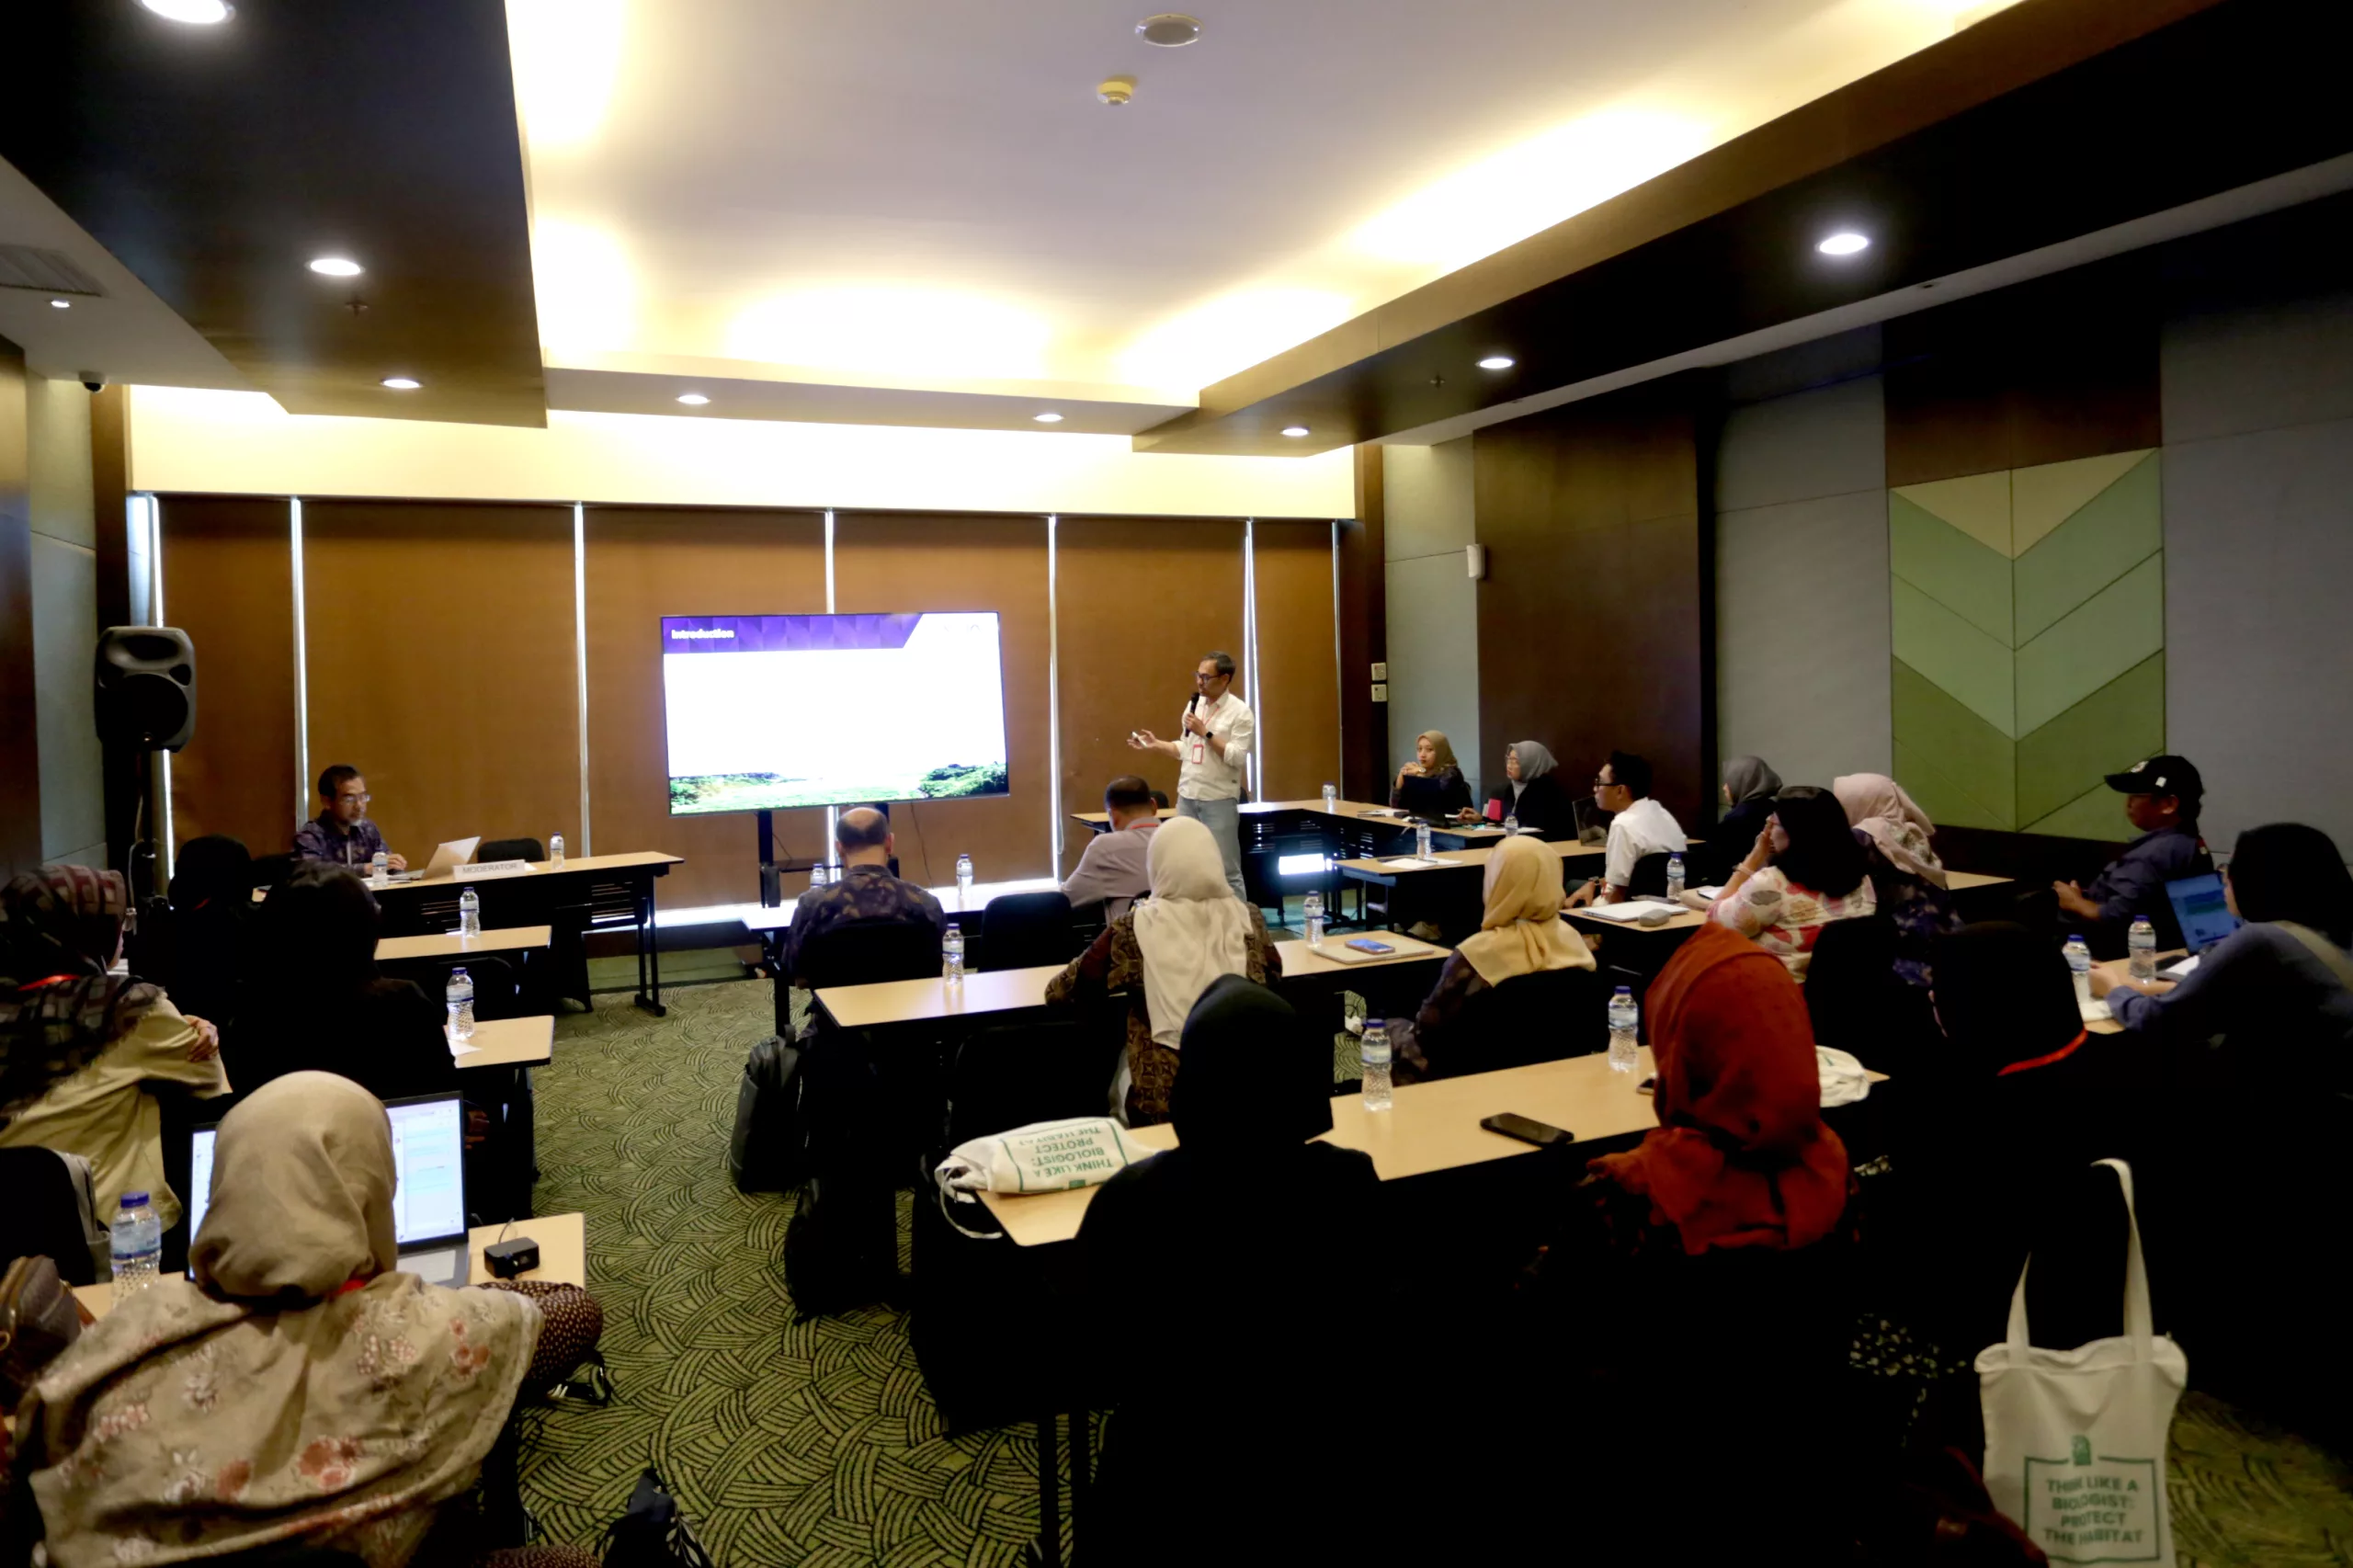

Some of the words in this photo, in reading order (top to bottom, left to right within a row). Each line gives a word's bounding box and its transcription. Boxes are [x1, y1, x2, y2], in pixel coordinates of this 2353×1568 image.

[671, 628, 734, 640] Introduction
[462, 862, 517, 873] MODERATOR
[1078, 1127, 1101, 1136] THE
[1035, 1138, 1094, 1153] PROTECT
[1031, 1146, 1105, 1166] BIOLOGIST:
[1044, 1165, 1072, 1177] LIKE
[1074, 1158, 1114, 1172] THINK
[1033, 1169, 1040, 1177] A
[2046, 1476, 2084, 1494] THINK
[2086, 1475, 2121, 1491] LIKE
[2127, 1478, 2141, 1493] A
[2060, 1510, 2127, 1528] PROTECT
[2043, 1528, 2076, 1545] THE
